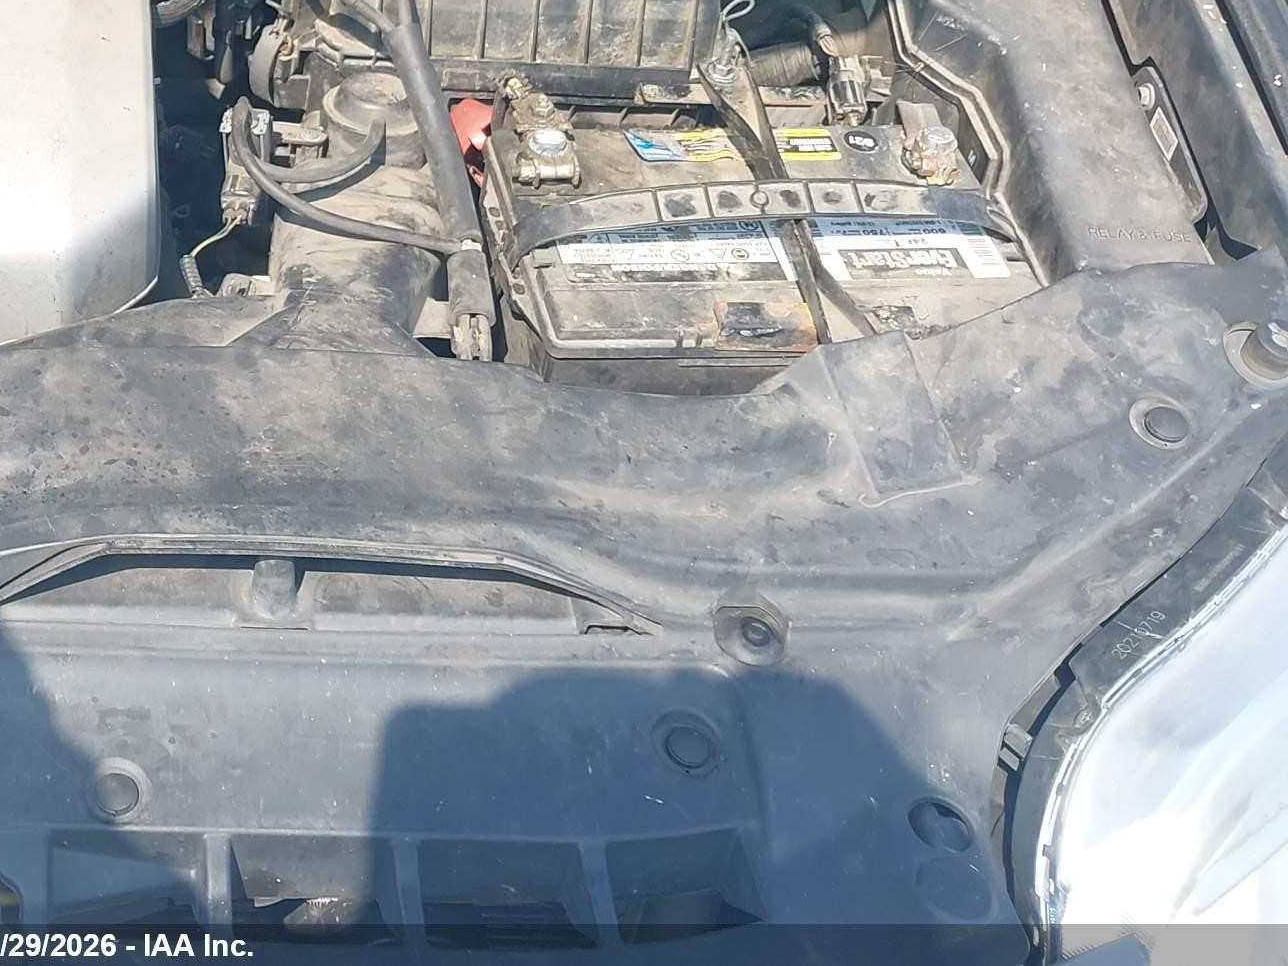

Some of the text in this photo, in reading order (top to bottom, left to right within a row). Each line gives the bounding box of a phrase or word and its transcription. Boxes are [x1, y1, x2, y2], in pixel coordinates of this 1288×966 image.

[1087, 226, 1135, 240] RELAY
[1152, 230, 1192, 243] FUSE
[848, 249, 958, 270] EverStart
[915, 267, 953, 276] Value
[1110, 610, 1167, 661] 20210719
